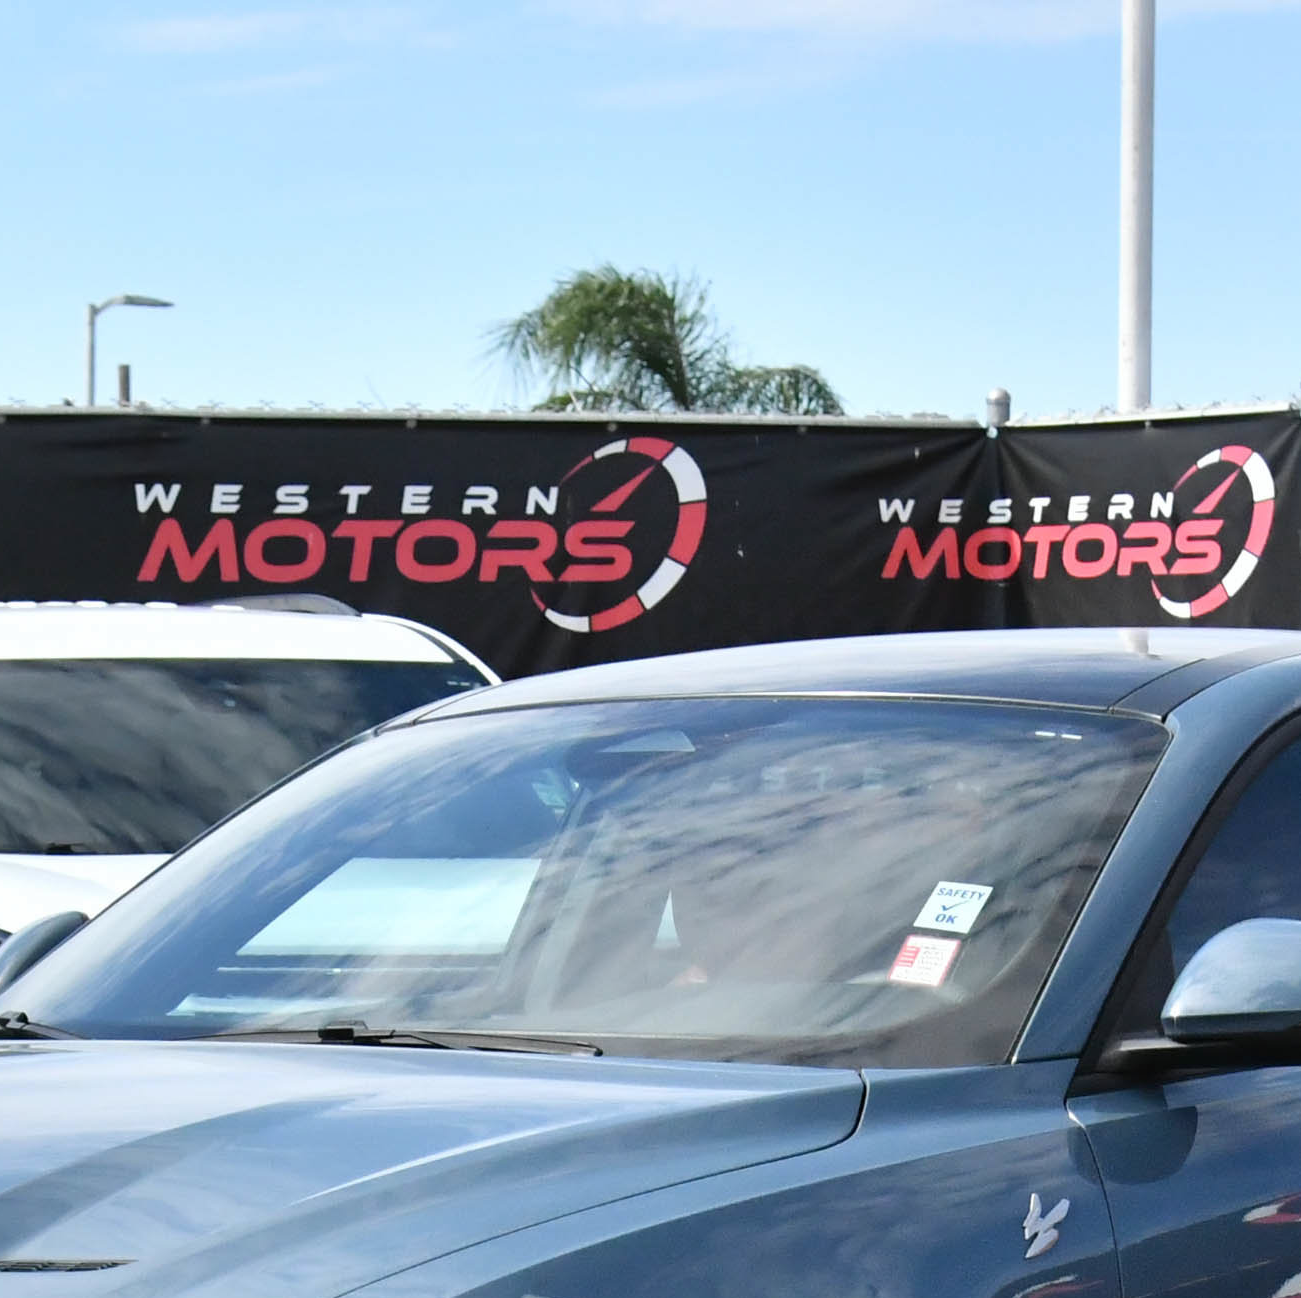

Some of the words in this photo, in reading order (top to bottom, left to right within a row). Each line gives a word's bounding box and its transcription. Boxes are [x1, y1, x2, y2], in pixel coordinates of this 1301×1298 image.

[135, 483, 558, 515] WESTERN
[879, 491, 1174, 524] WESTERN
[138, 518, 634, 583] MOTORS
[882, 518, 1224, 581] MOTORS
[937, 887, 986, 901] SAFETY
[935, 913, 958, 925] OK
